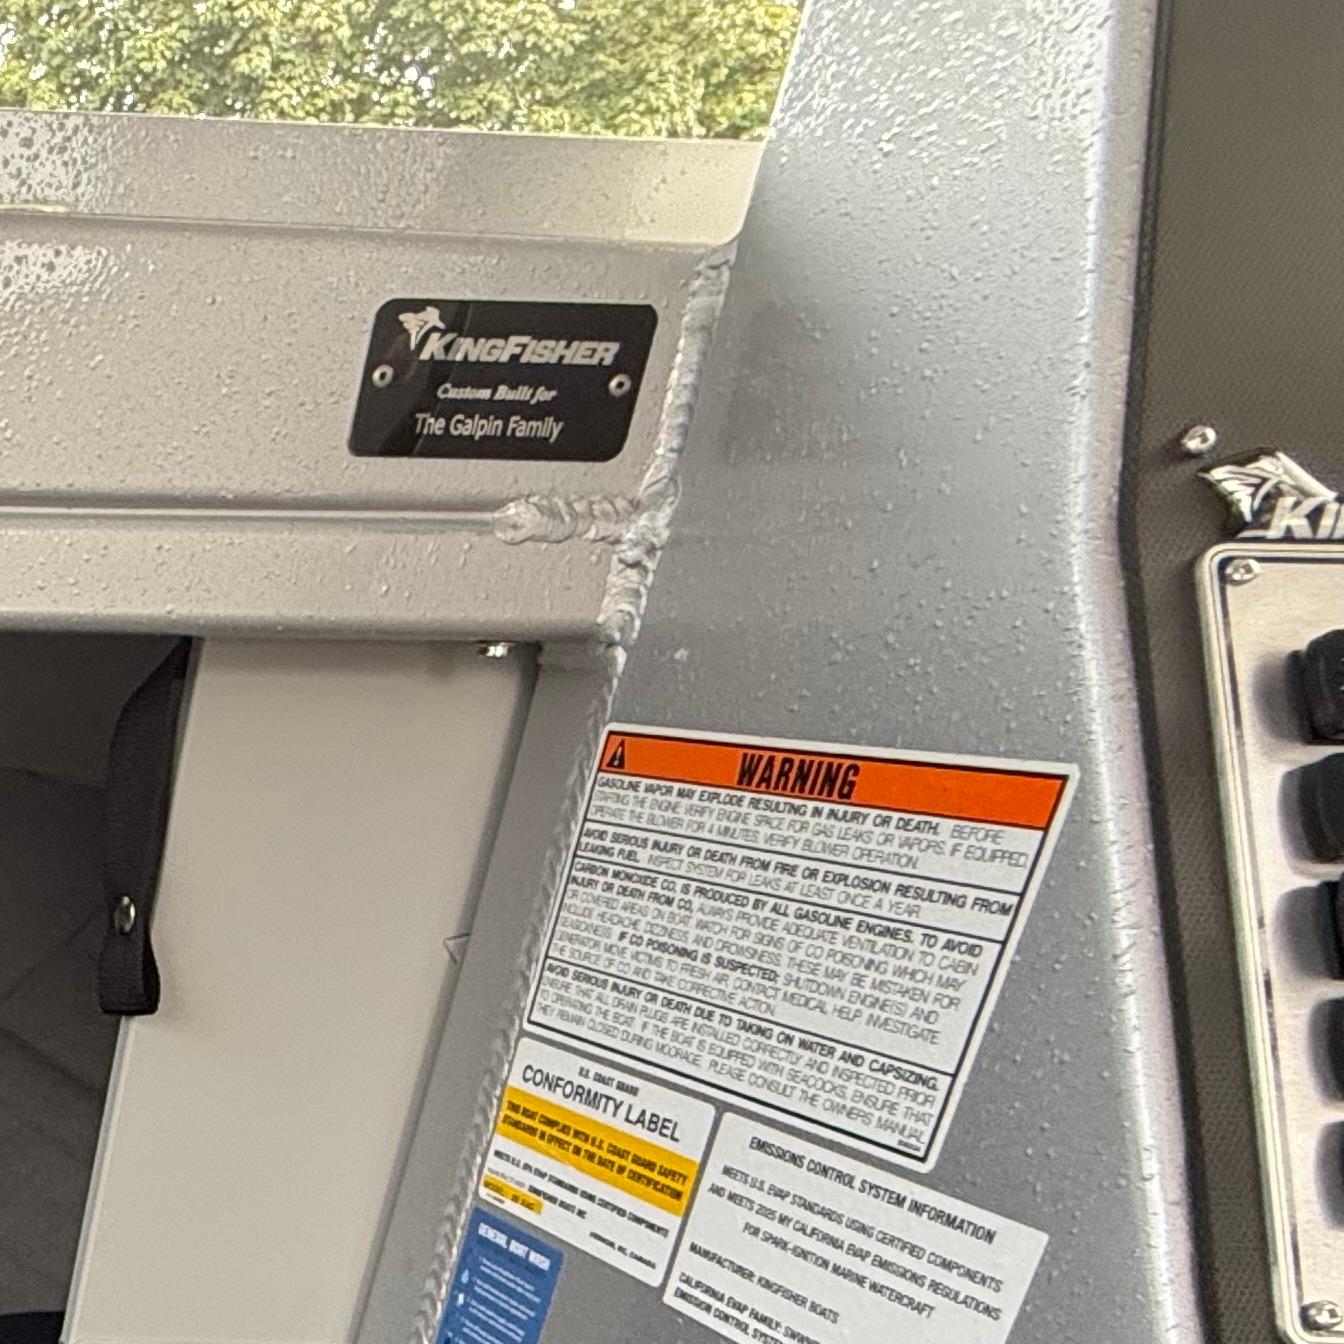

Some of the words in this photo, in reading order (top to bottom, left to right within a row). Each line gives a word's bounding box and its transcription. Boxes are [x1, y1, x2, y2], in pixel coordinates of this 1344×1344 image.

[437, 383, 493, 400] Custom
[493, 385, 533, 401] Built
[529, 386, 558, 404] for
[415, 413, 446, 436] The
[449, 414, 504, 440] Galpin
[506, 416, 564, 443] Family
[736, 753, 859, 799] WARNING
[747, 797, 807, 816] RESULTING
[810, 806, 823, 817] IN
[825, 808, 870, 824] INJURY
[872, 813, 892, 827] OR
[894, 817, 939, 835] DEATH.
[703, 849, 737, 864] DEATH
[739, 855, 770, 871] FROM
[773, 861, 798, 877] FIRE
[801, 866, 819, 879] OR
[821, 870, 891, 893] EXPLOSION
[894, 883, 967, 908] RESULTING
[970, 897, 1013, 915] FROM
[693, 885, 749, 907] PRODUCED
[752, 898, 767, 910] BY
[769, 902, 788, 917] ALL
[794, 907, 853, 930] GASOLINE
[855, 919, 912, 942] ENGINES.
[920, 933, 937, 948] TO
[940, 938, 982, 957] AVOID
[700, 952, 712, 964] IS
[714, 955, 779, 983] SUSPECTED;
[661, 996, 691, 1014] DEATH
[693, 1006, 714, 1021] DUE
[718, 1013, 732, 1026] TO
[737, 1018, 772, 1039] TAKING
[776, 1031, 794, 1045] ON
[798, 1037, 836, 1058] WATER
[838, 1050, 864, 1067] AND
[868, 1059, 937, 1091] CAPSIZING.
[522, 1064, 623, 1117] CONFORMITY
[624, 1104, 679, 1142] LABEL
[749, 1136, 805, 1168] EMISSIONS
[806, 1159, 854, 1189] CONTROL
[858, 1179, 906, 1208] SYSTEM
[907, 1199, 996, 1244] INFORMATION
